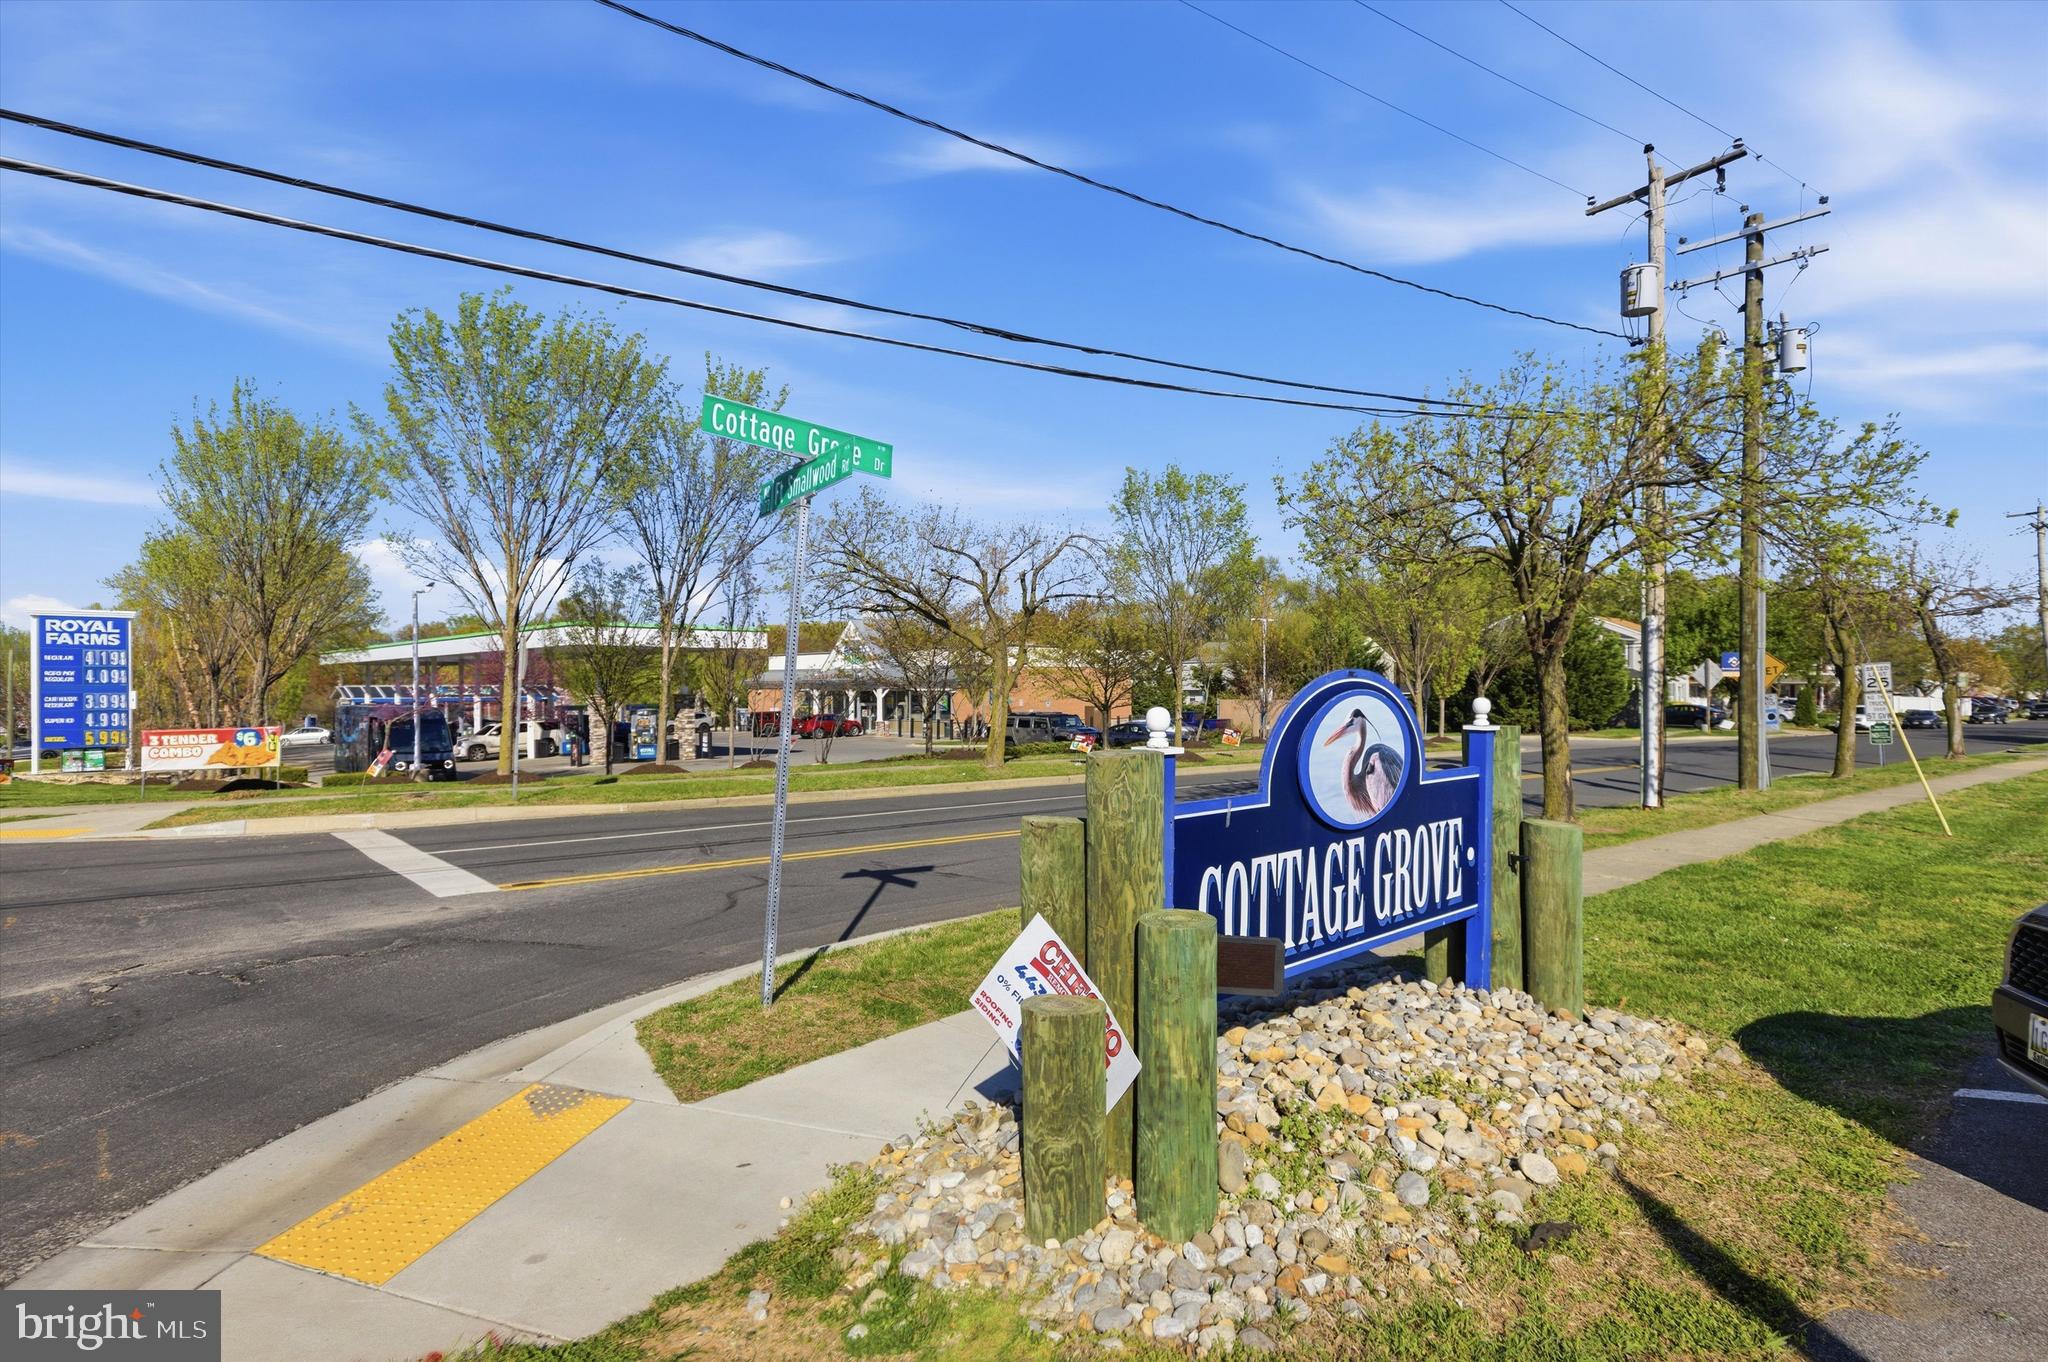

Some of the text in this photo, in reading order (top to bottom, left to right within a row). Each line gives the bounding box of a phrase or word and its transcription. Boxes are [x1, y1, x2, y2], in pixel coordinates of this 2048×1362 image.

[711, 403, 886, 472] Cottage Groe Dr
[786, 454, 837, 500] Smallwood
[45, 619, 120, 633] ROYAL
[45, 632, 120, 646] FARMS
[1866, 677, 1890, 688] 25
[149, 731, 257, 746] 3 TENDER $6
[149, 747, 202, 758] COMBO
[1198, 817, 1464, 950] COTTAGE GROVE
[996, 974, 1012, 992] 0%
[974, 997, 1001, 1027] SIDING
[979, 990, 1014, 1029] ROOFING
